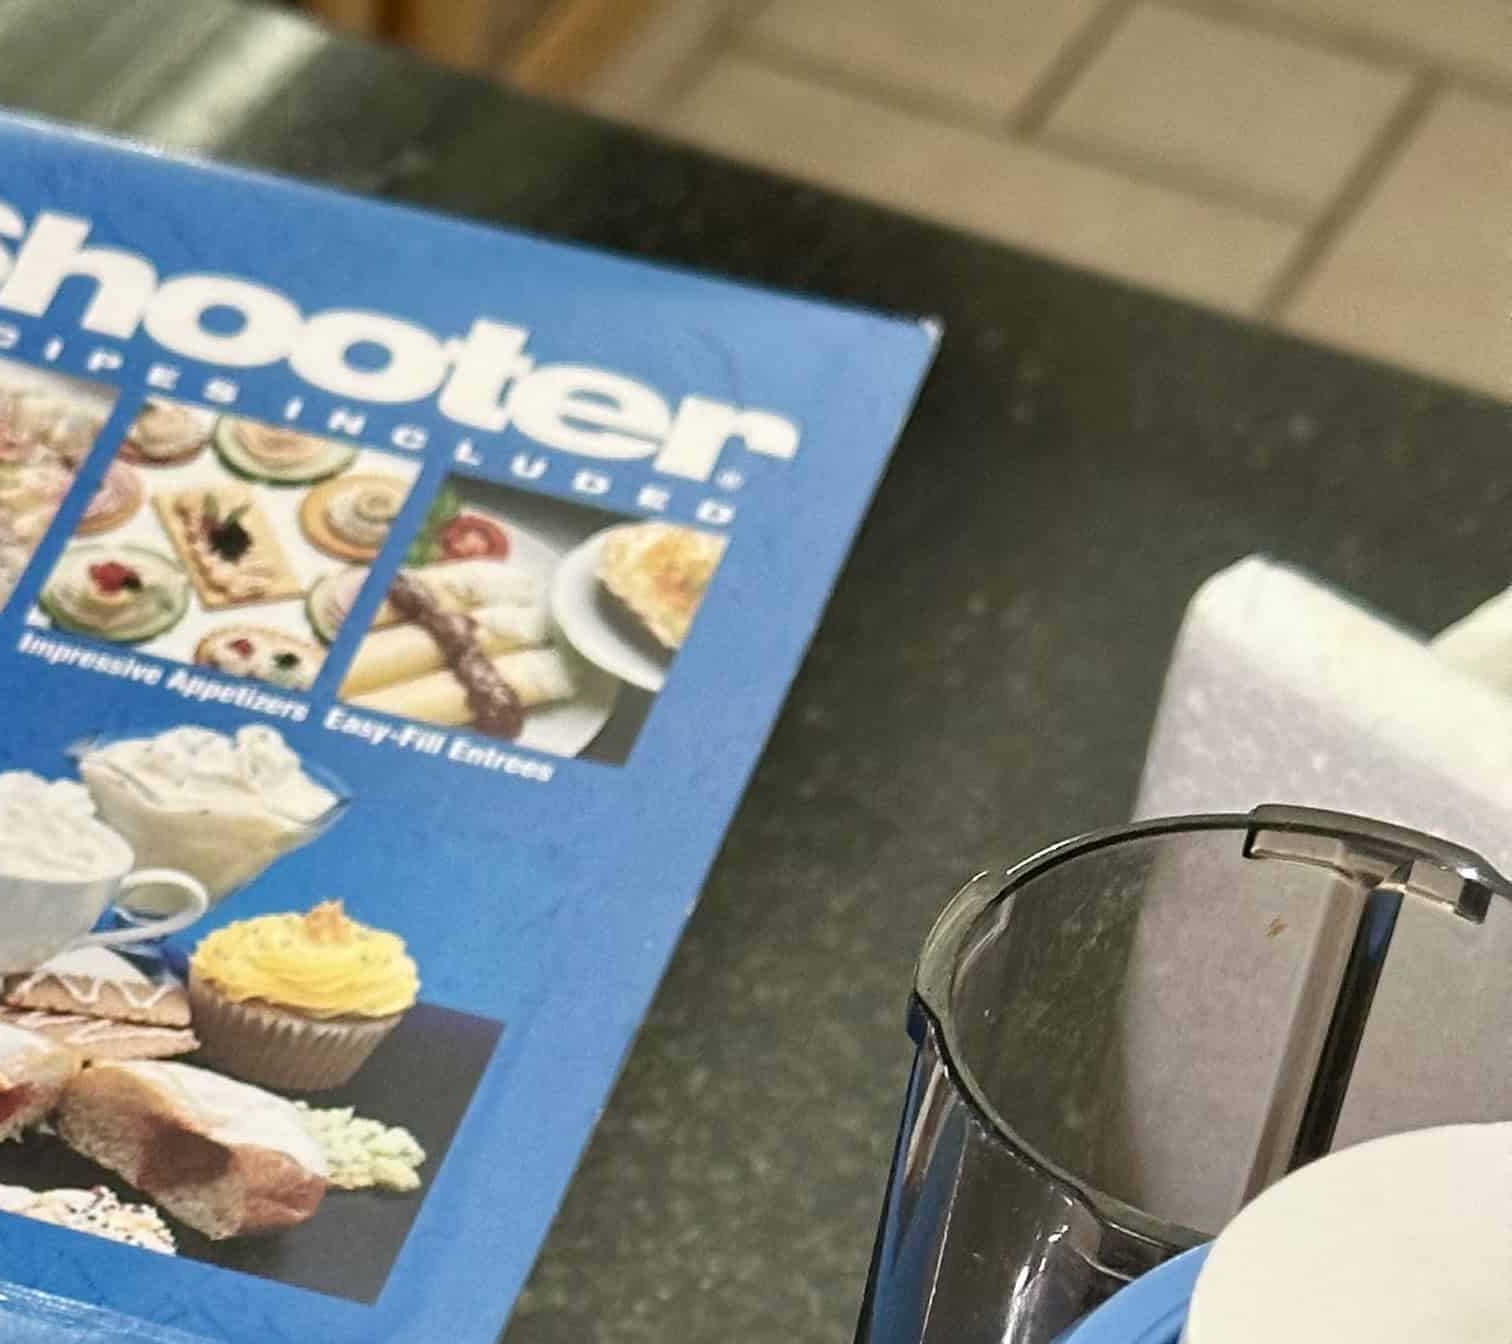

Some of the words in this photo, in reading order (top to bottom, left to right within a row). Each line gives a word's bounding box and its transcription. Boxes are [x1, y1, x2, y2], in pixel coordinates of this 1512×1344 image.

[284, 397, 737, 526] INCLUDED
[16, 632, 166, 687] Impressive
[166, 668, 309, 723] Appetizers
[322, 705, 444, 756] Easy-Fill
[449, 740, 558, 784] Entrees
